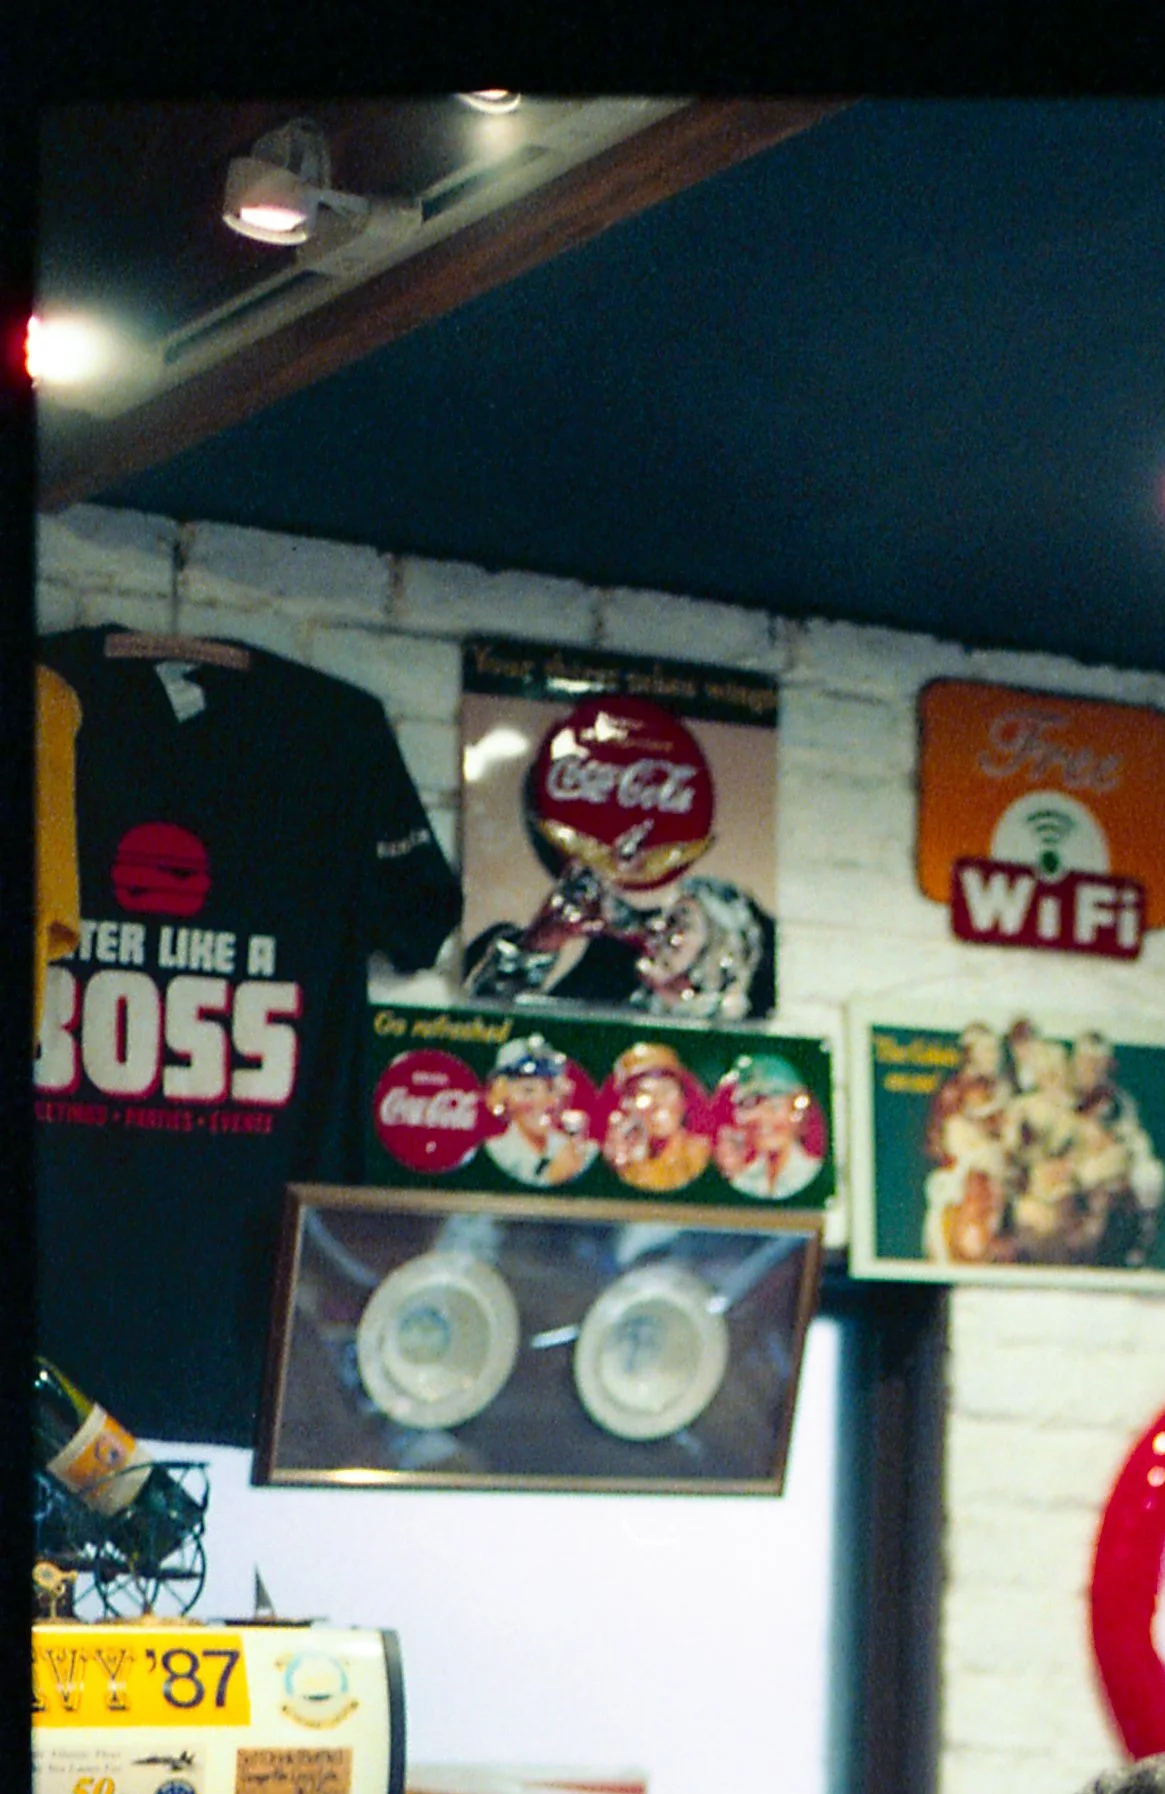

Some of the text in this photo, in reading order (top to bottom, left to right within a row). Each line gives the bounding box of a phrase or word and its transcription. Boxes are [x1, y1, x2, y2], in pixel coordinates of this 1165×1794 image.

[976, 707, 1122, 793] Free
[545, 752, 699, 815] Coca-Cola
[960, 868, 1139, 949] WiFi
[158, 925, 236, 974] LIKE
[247, 934, 276, 977] A
[379, 1086, 478, 1132] Coca-Cola
[33, 1647, 241, 1713] VY '87
